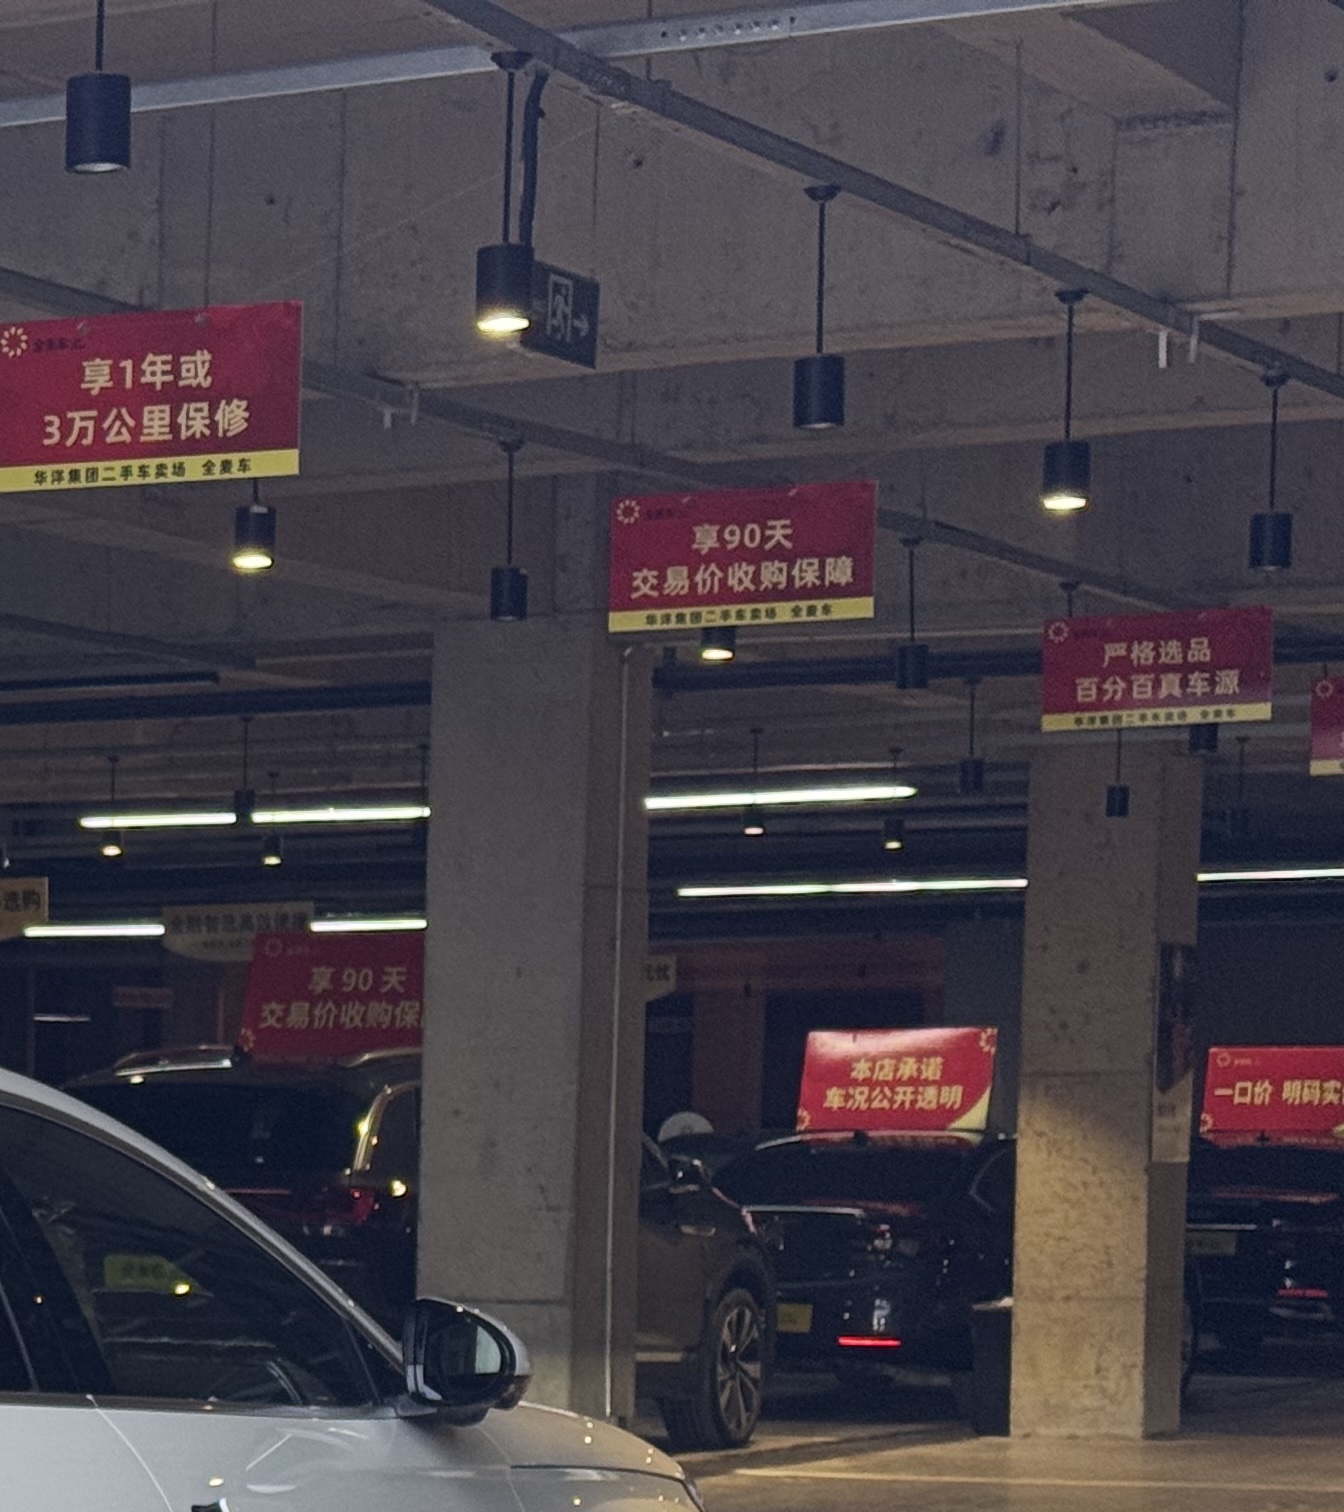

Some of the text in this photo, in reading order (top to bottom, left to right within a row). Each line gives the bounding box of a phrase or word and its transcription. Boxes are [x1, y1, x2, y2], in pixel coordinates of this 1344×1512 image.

[80, 350, 213, 395] 享1年或
[42, 398, 250, 447] 3万公里保修
[691, 518, 794, 555] 享90天
[630, 556, 855, 599] 交易价收购保障
[1102, 637, 1212, 668] 严格选品
[1074, 669, 1241, 703] 百分百真车源
[258, 1000, 424, 1029] 交易价收购保
[849, 1055, 946, 1082] 本店承诺
[822, 1084, 965, 1111] 车况公开透明
[1213, 1078, 1344, 1106] 一口价 明码实
